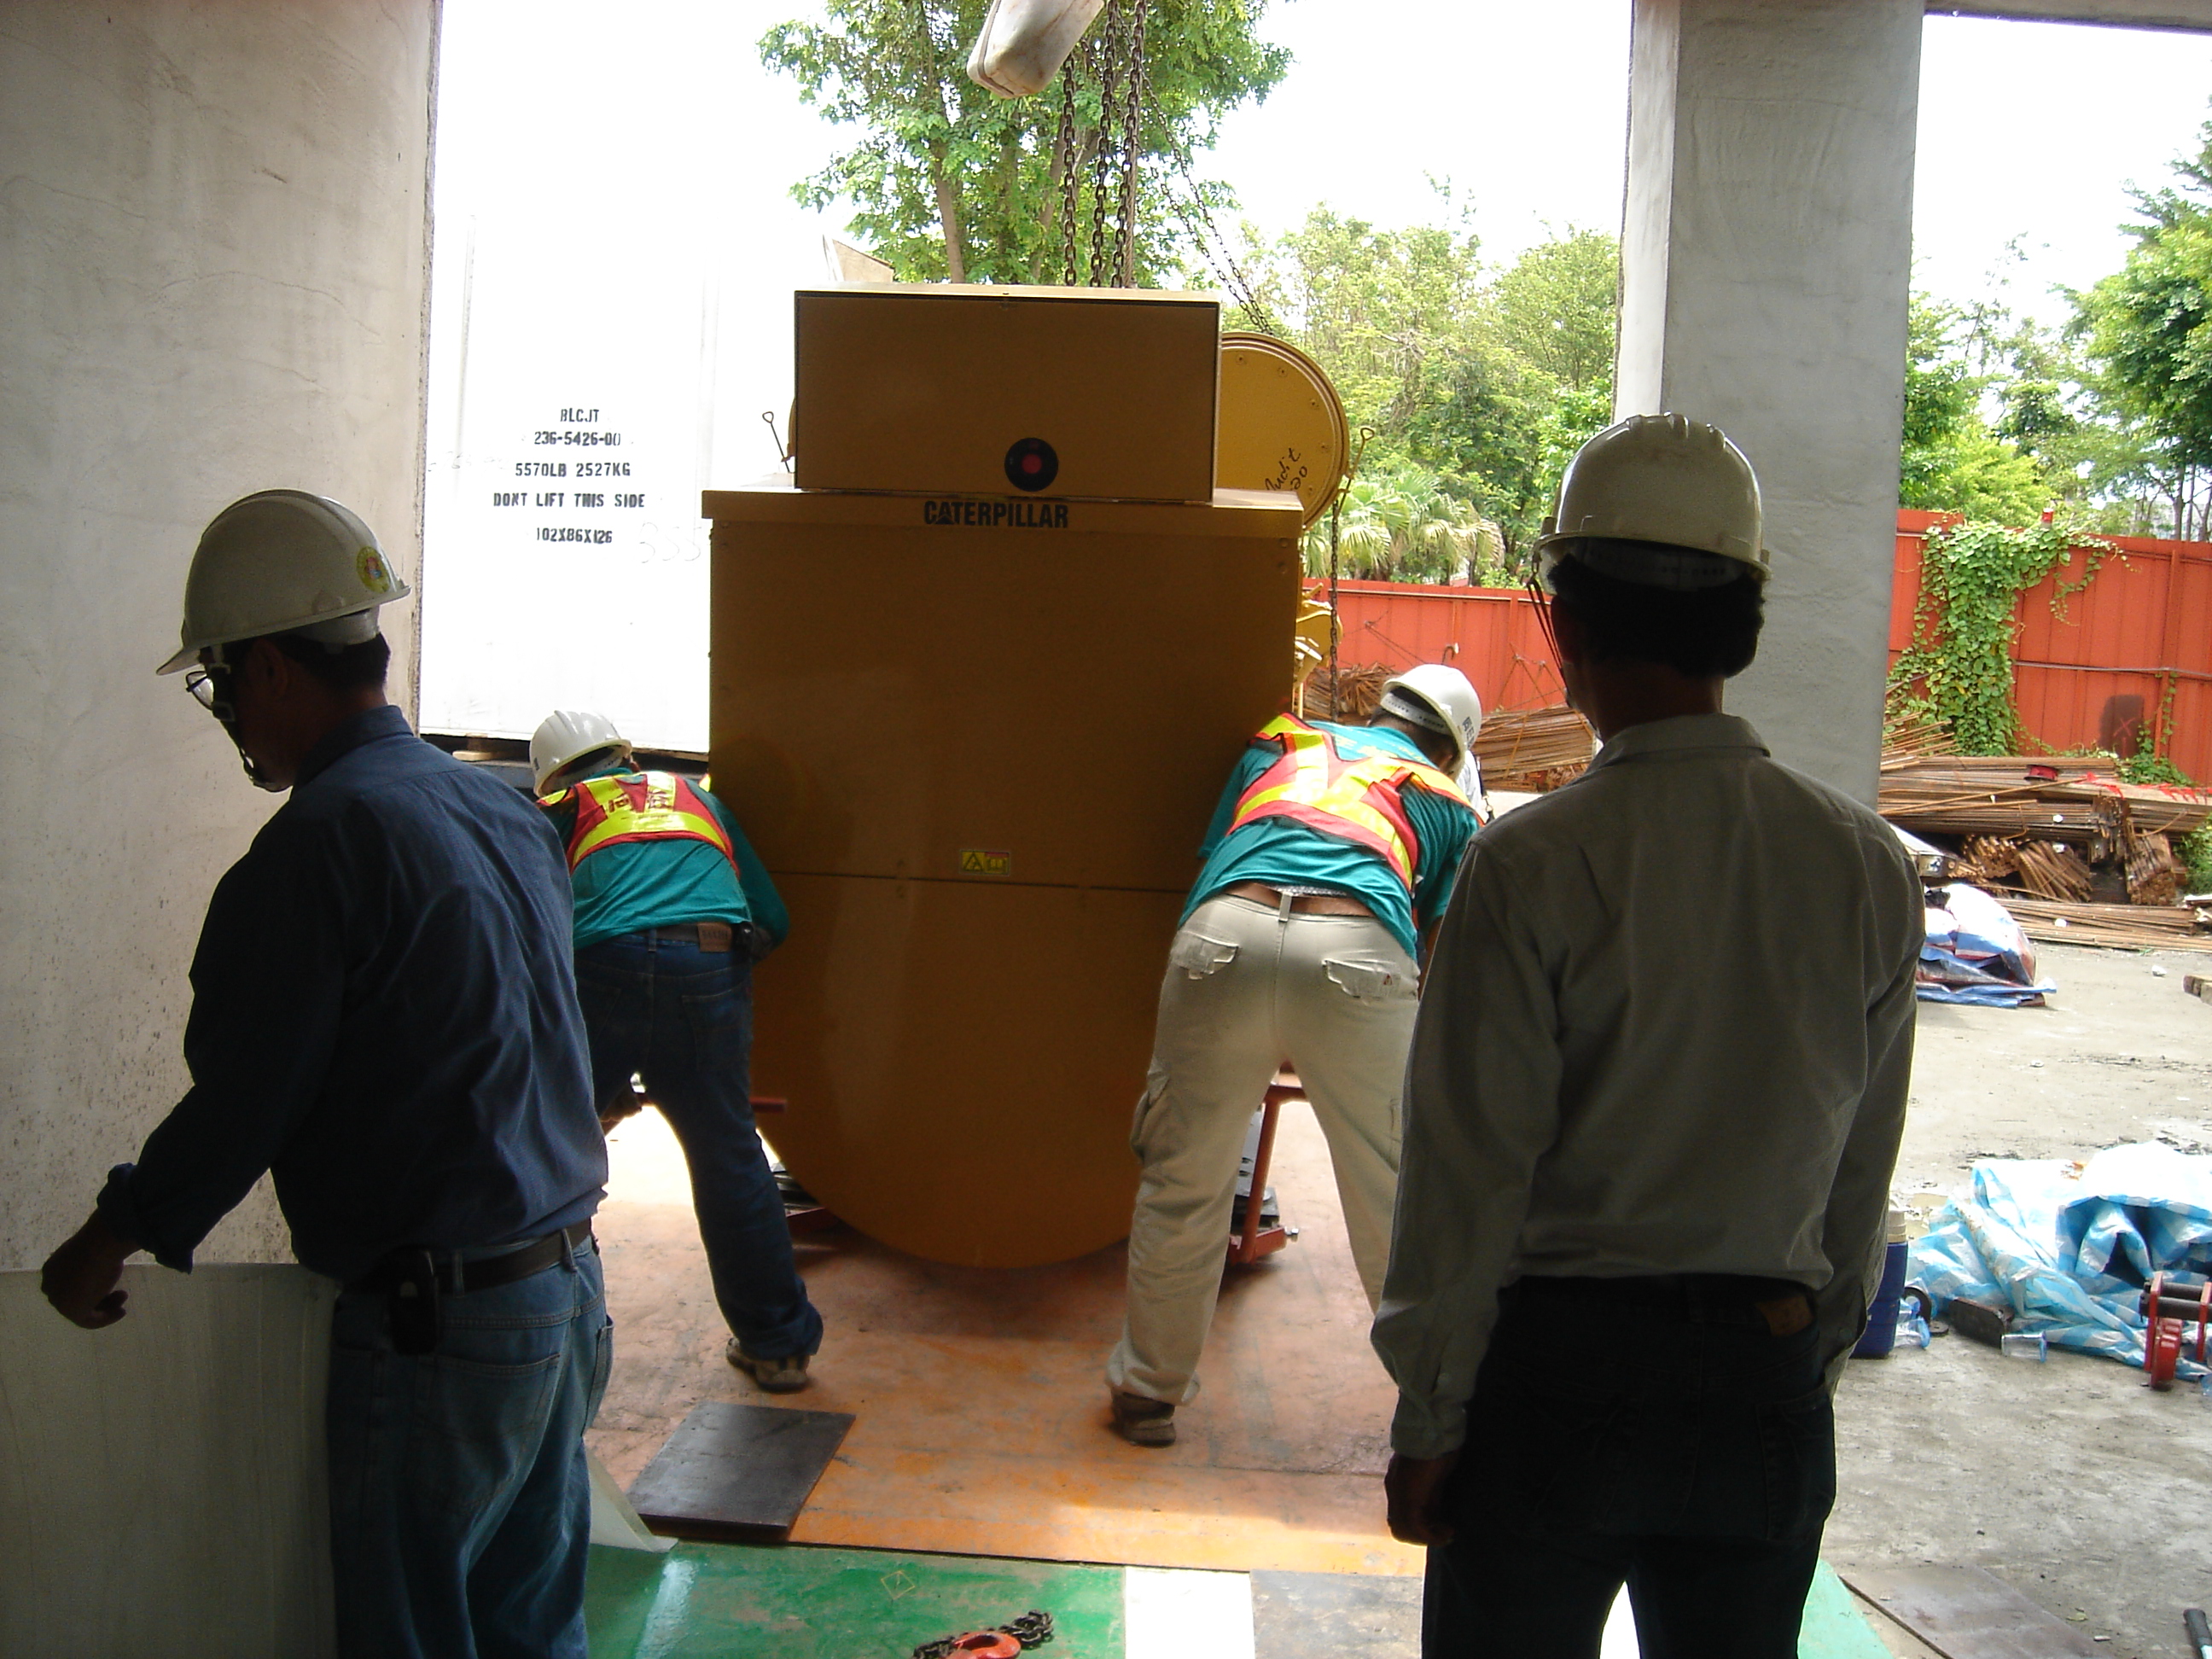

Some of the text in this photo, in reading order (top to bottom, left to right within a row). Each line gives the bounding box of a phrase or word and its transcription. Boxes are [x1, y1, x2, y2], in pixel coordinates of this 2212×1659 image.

[515, 462, 631, 478] 5570LB 2527KG
[536, 492, 565, 508] LIFT
[574, 493, 604, 509] THIS
[614, 493, 645, 508] SIDE
[923, 500, 1068, 528] CATERPILLAR
